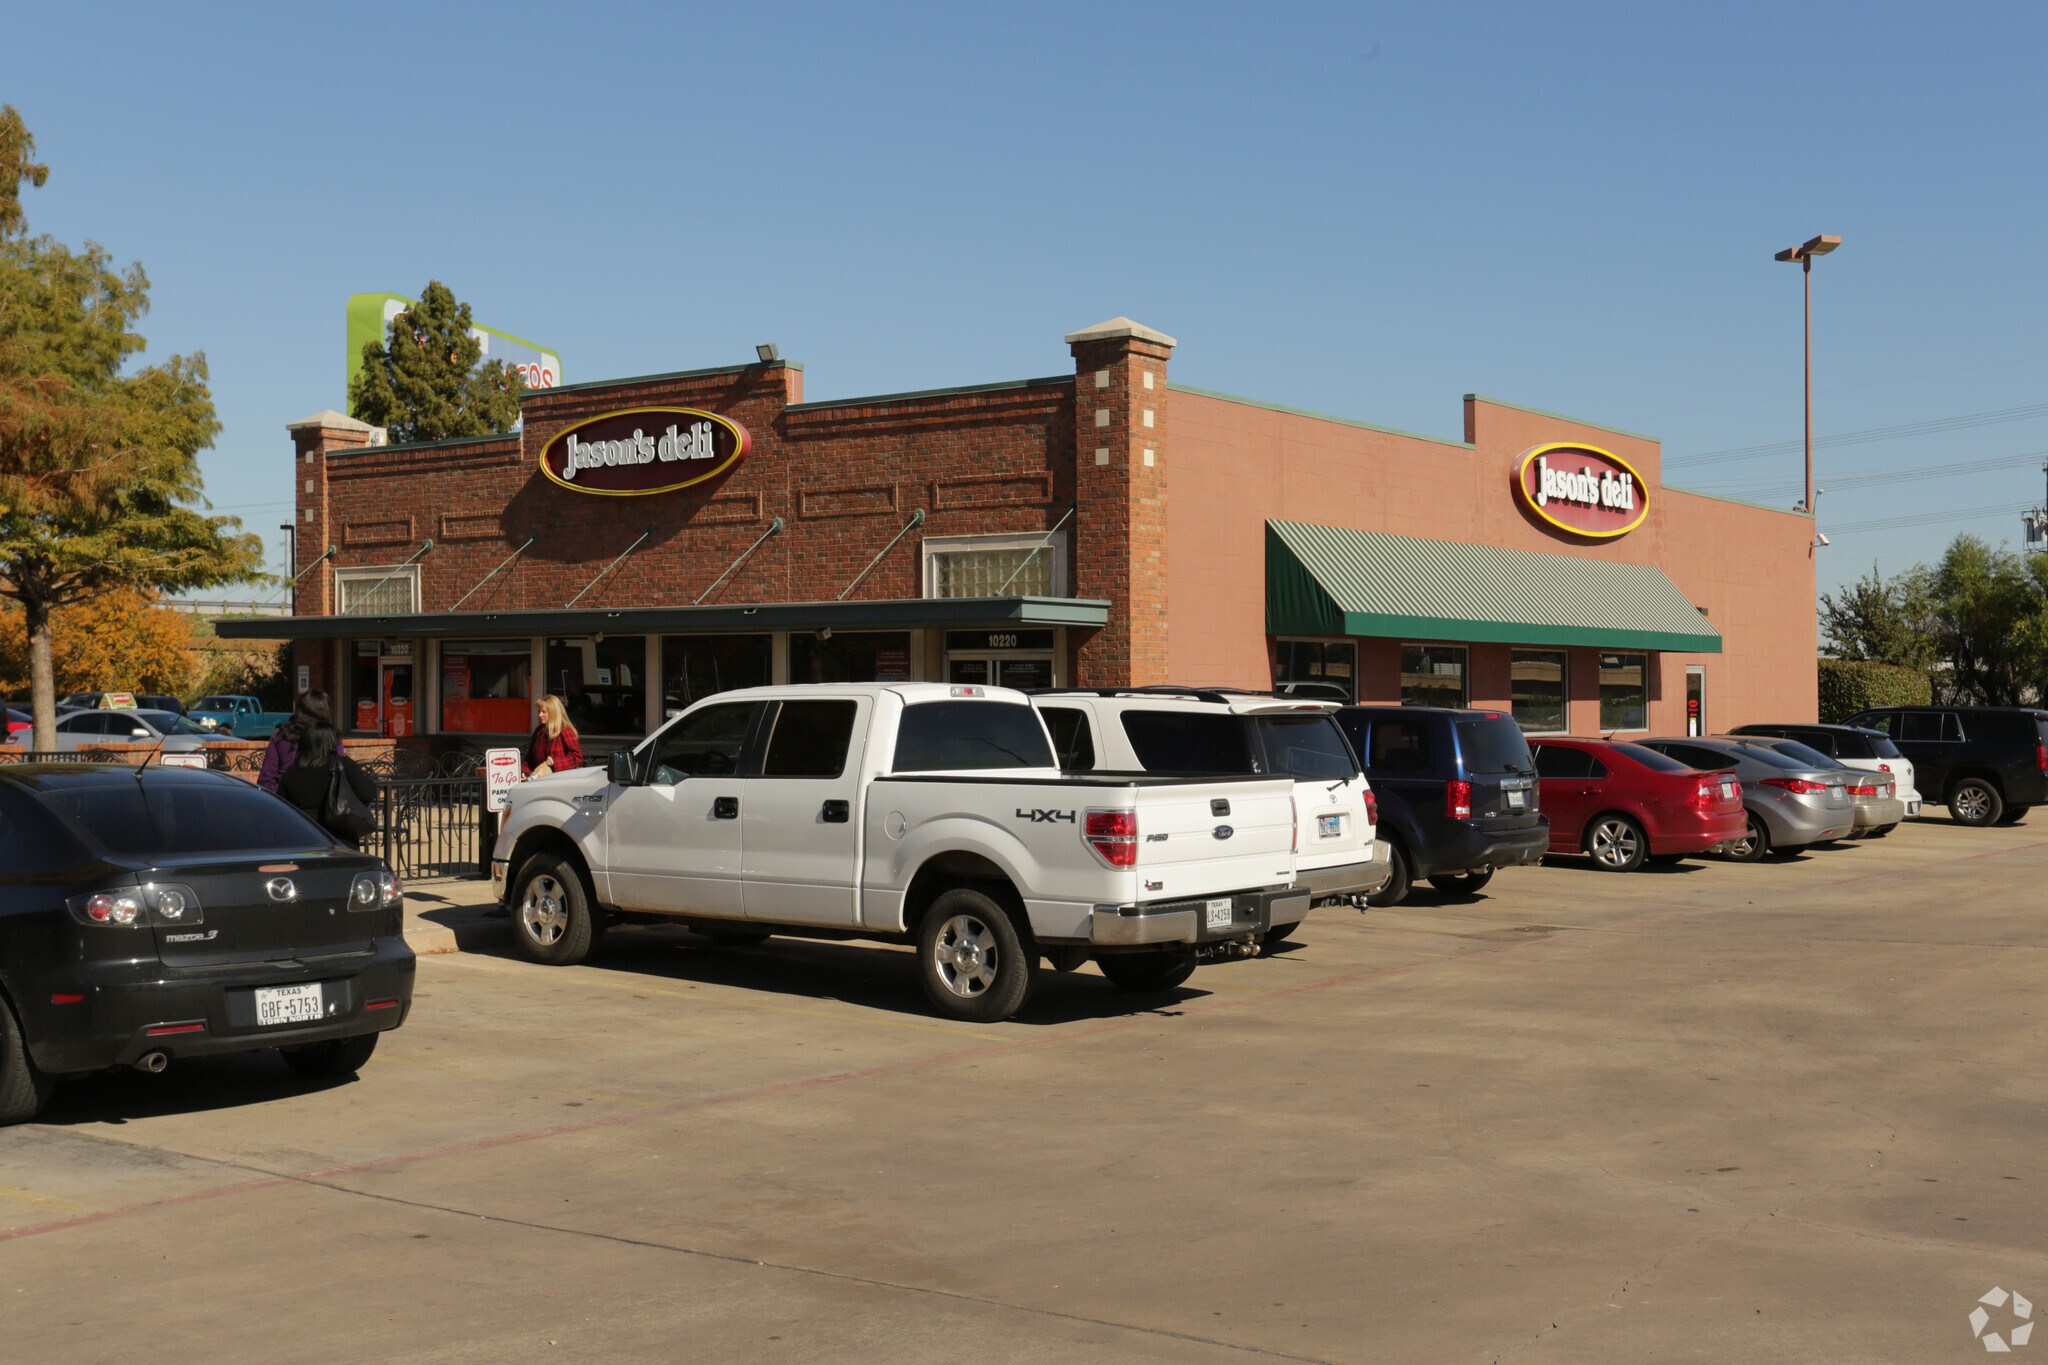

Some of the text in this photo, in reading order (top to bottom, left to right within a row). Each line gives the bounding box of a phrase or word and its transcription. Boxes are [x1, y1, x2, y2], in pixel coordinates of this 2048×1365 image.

[563, 421, 714, 480] Jason's deli
[1537, 456, 1634, 510] Jason's deli
[988, 634, 1017, 648] 10220
[390, 644, 409, 655] 10220
[491, 771, 518, 786] To Go
[276, 987, 302, 997] TEXAS
[261, 1013, 321, 1026] TOWN NORTH
